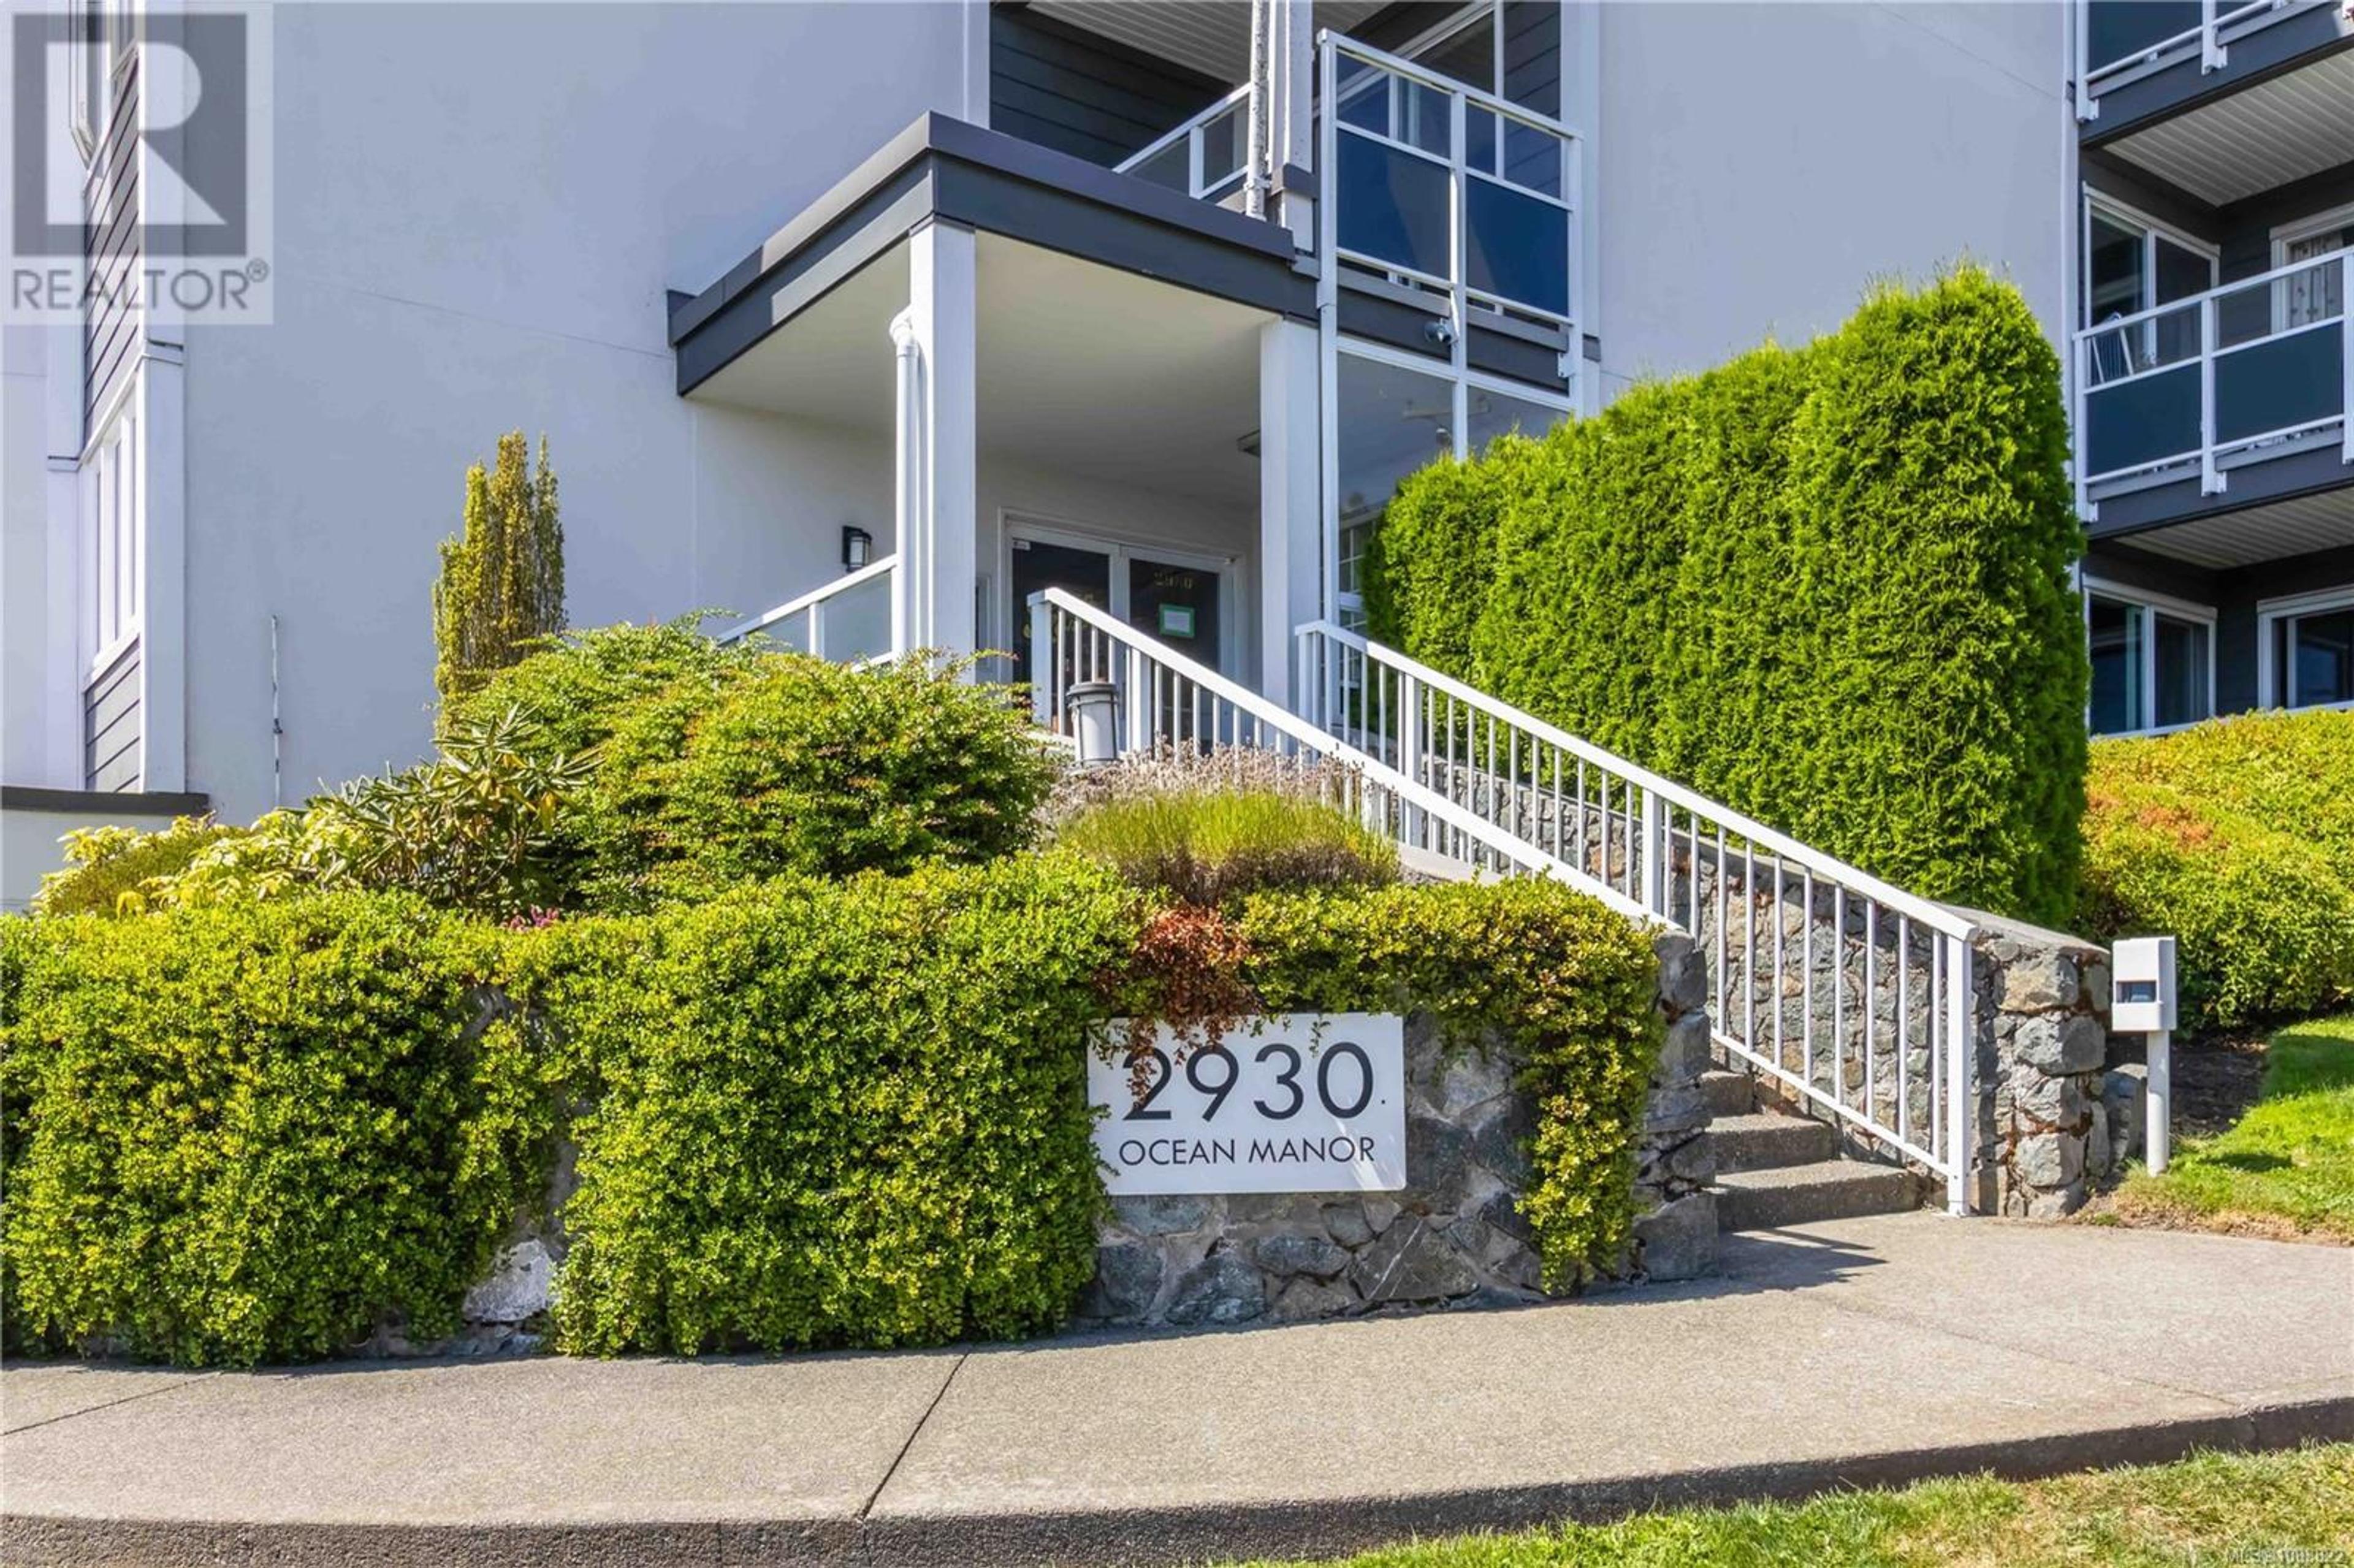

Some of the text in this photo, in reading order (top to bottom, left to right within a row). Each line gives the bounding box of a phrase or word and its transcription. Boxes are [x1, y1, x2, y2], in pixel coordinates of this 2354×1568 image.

[1122, 1042, 1373, 1122] 2930
[1119, 1136, 1375, 1166] OCEAN MANOR
